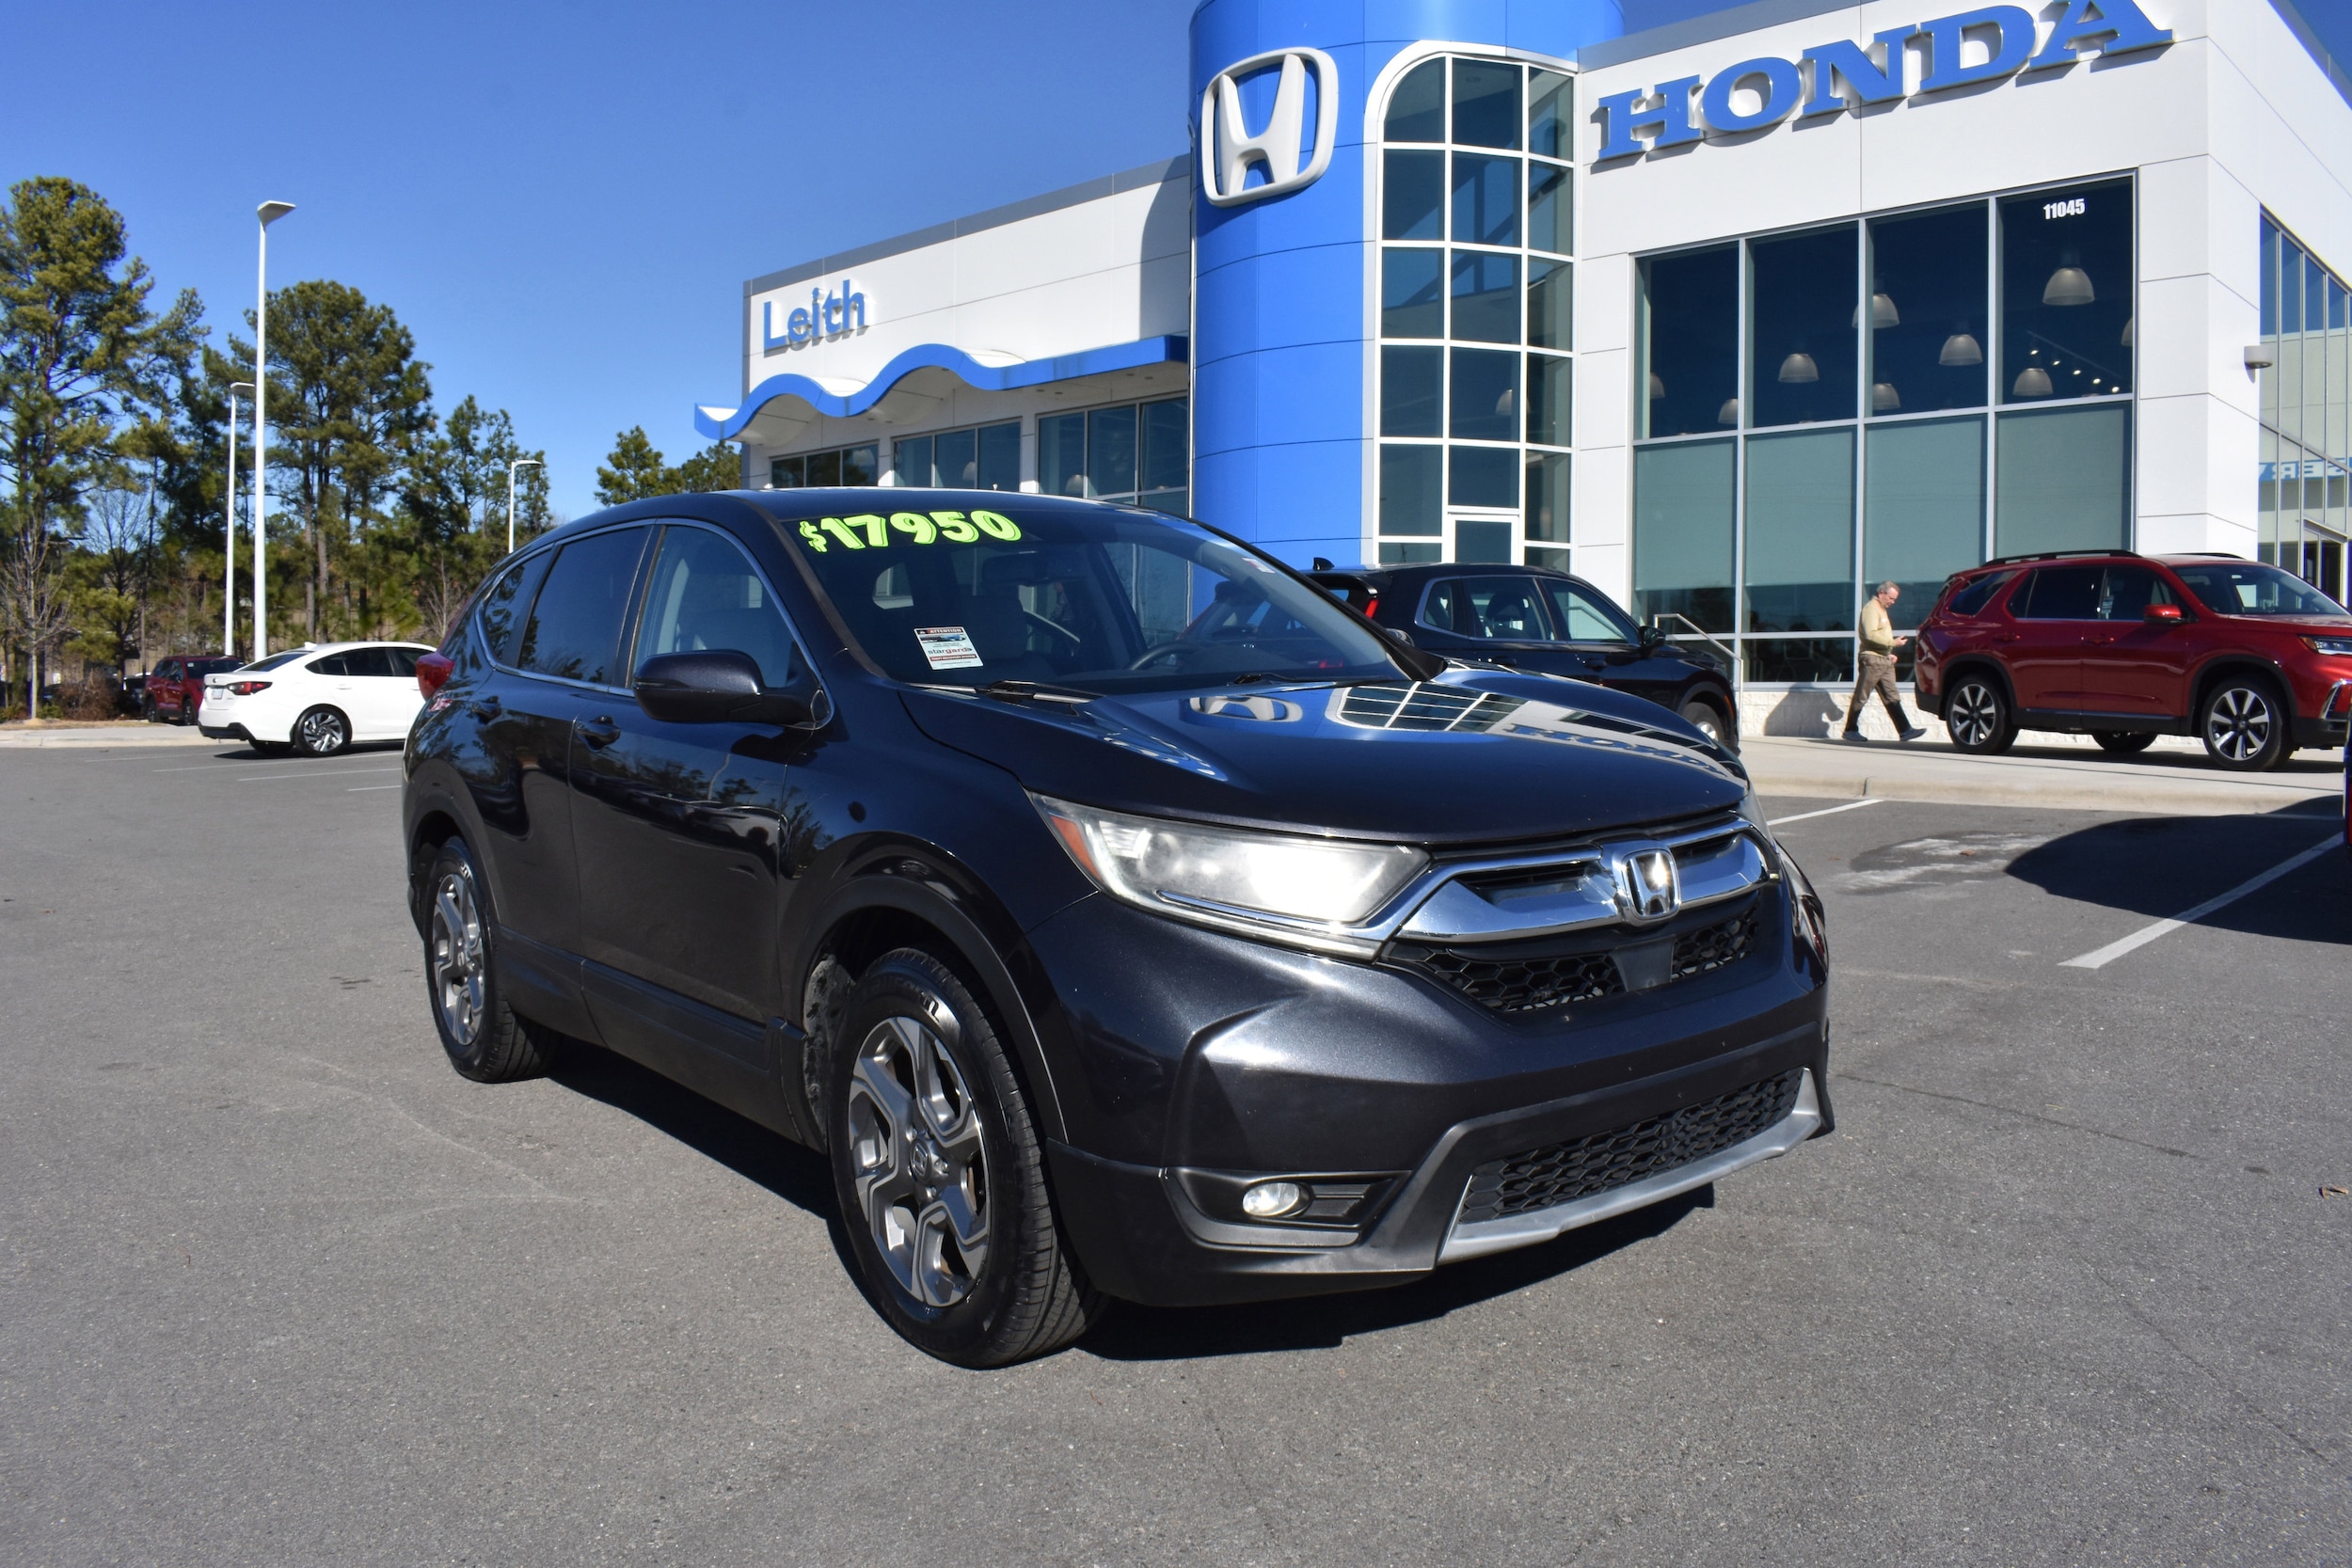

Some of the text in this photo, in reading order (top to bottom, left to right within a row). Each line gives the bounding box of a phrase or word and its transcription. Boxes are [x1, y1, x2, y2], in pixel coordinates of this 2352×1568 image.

[1598, 0, 2173, 161] HONDA
[2042, 198, 2086, 220] 11045
[763, 279, 866, 350] Leith
[799, 510, 1022, 553] $17950
